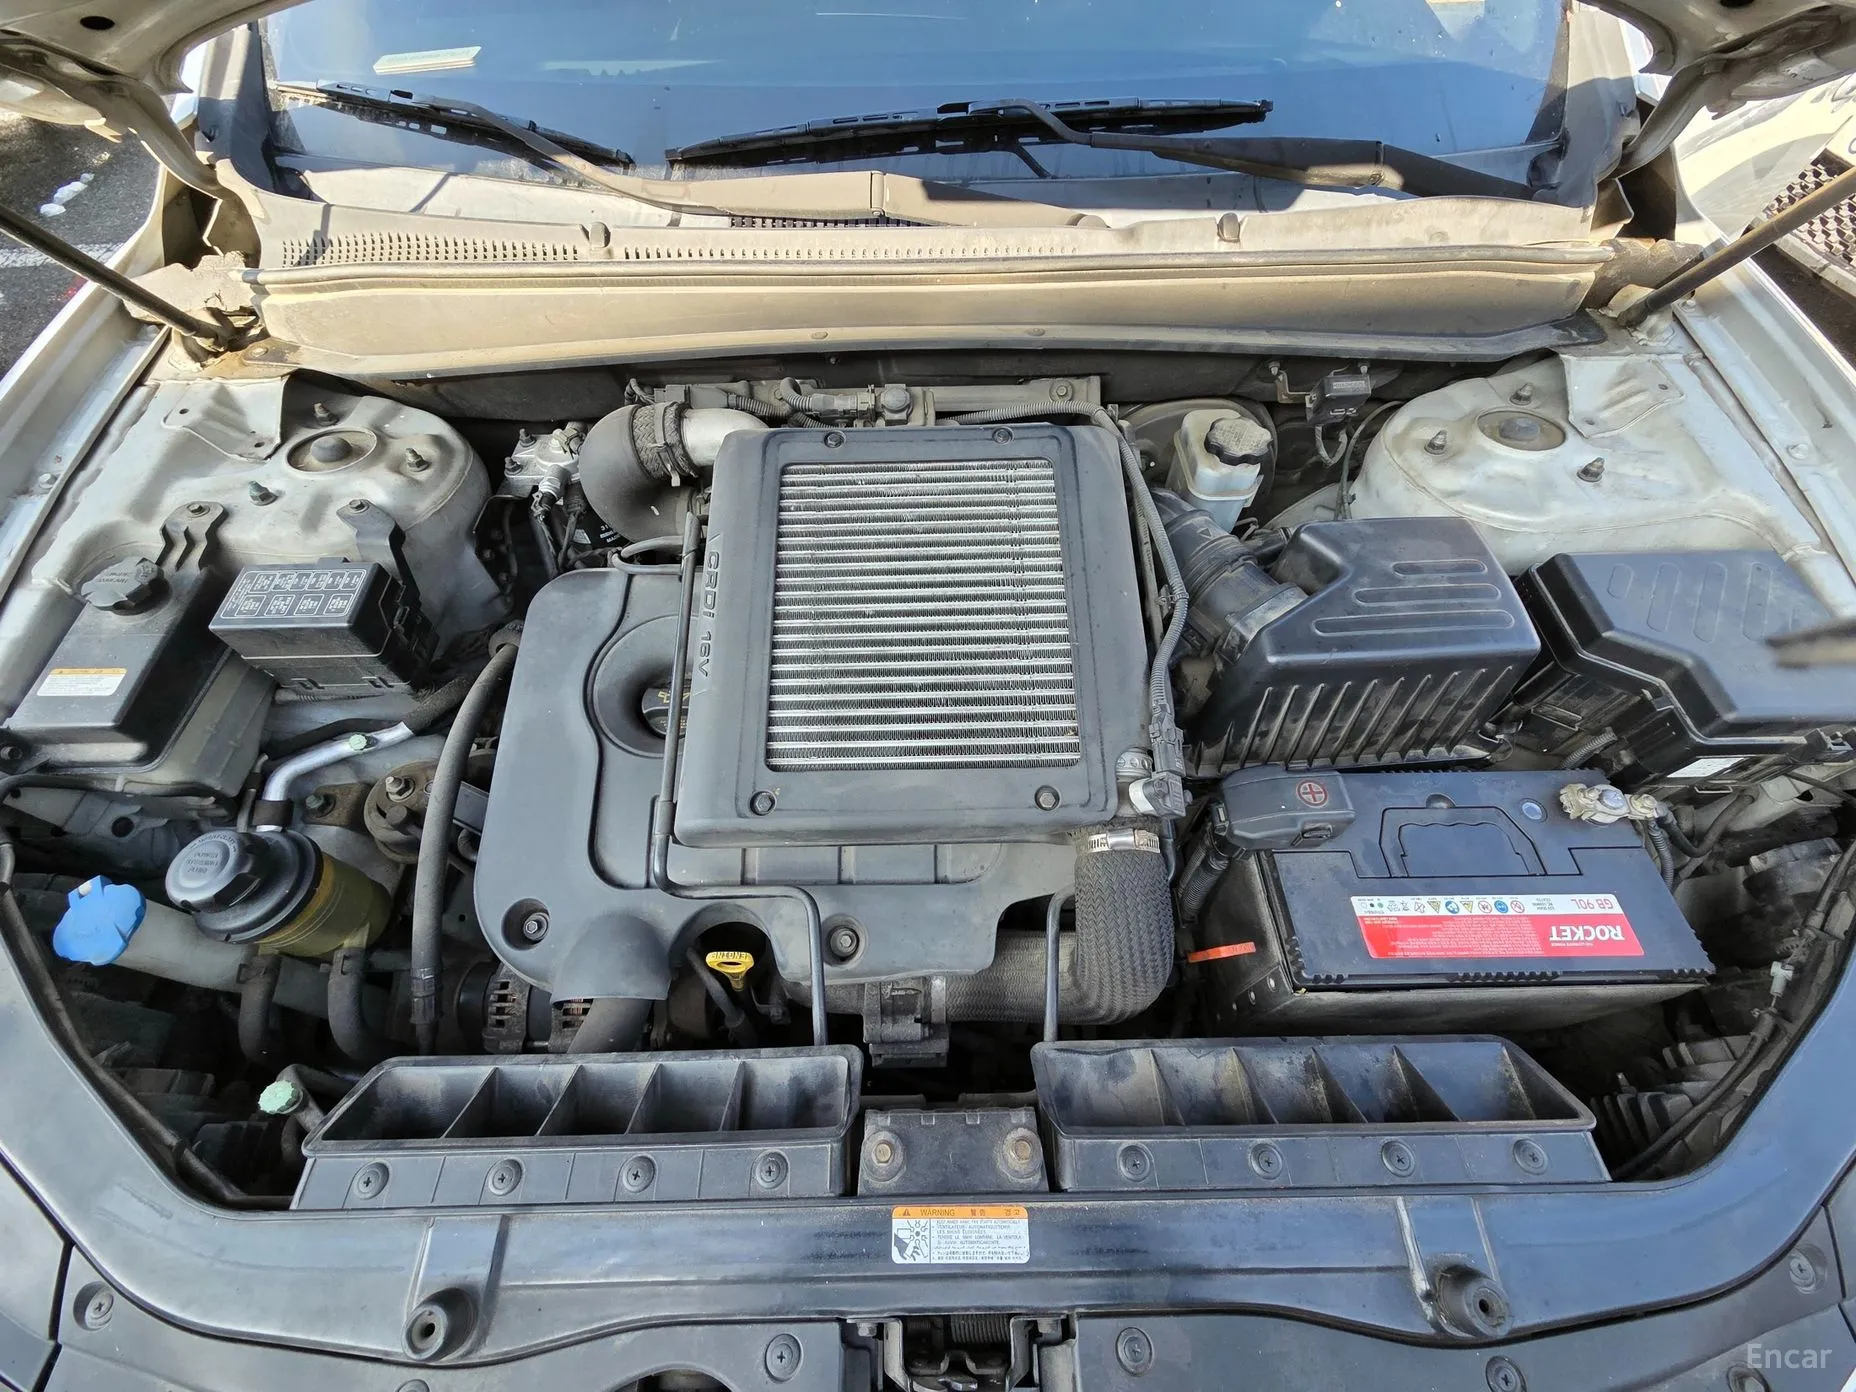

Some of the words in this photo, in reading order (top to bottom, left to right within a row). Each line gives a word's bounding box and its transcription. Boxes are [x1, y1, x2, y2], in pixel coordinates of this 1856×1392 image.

[702, 551, 720, 618] CRDi
[698, 630, 712, 677] 16V
[1571, 898, 1595, 910] 90L
[1598, 898, 1614, 910] GB
[1549, 925, 1625, 941] ROCKET
[711, 951, 748, 960] ENGINE
[920, 1208, 955, 1217] WARNING
